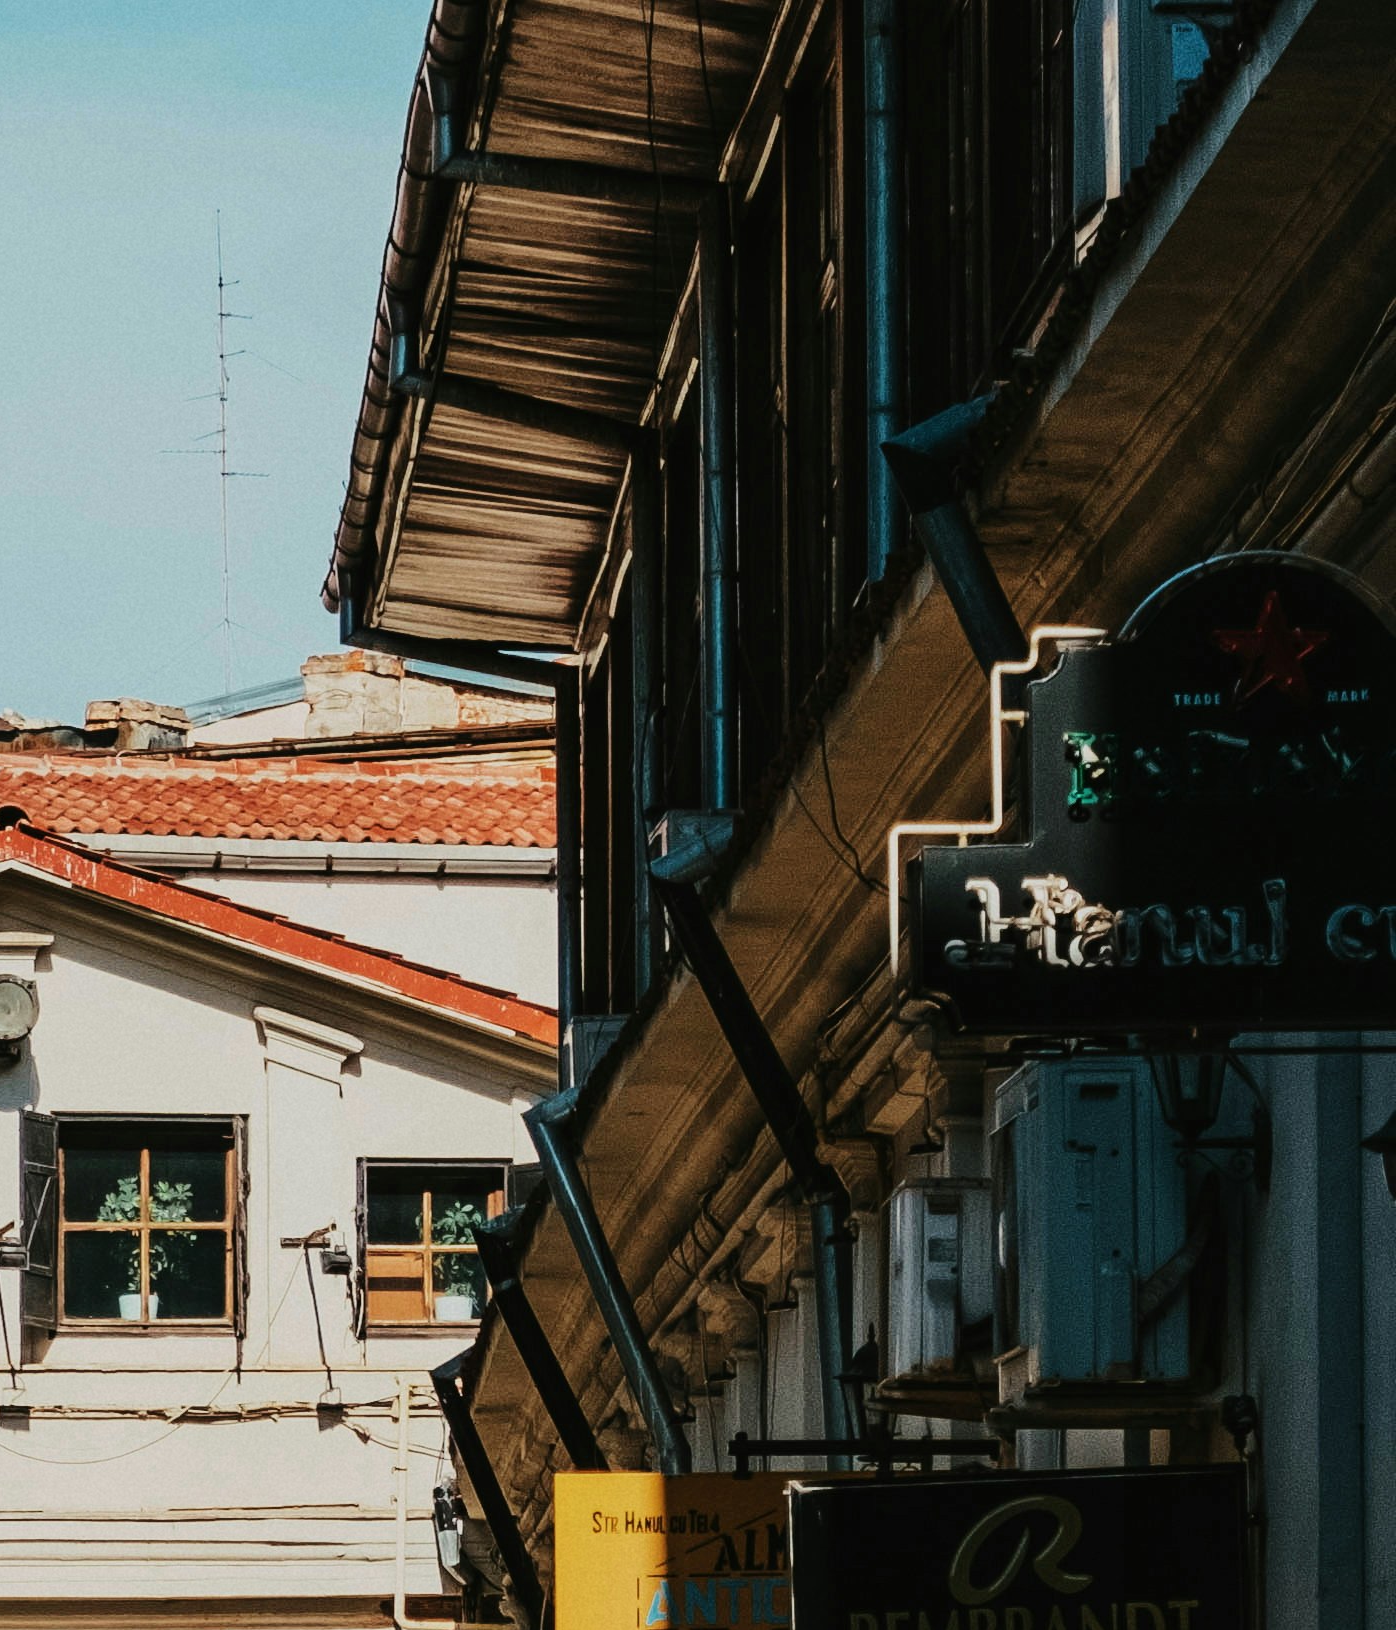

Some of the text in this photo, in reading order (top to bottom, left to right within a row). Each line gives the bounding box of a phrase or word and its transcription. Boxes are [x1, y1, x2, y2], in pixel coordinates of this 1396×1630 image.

[1173, 688, 1371, 708] TRADE MARK
[944, 873, 1396, 968] Hanul c
